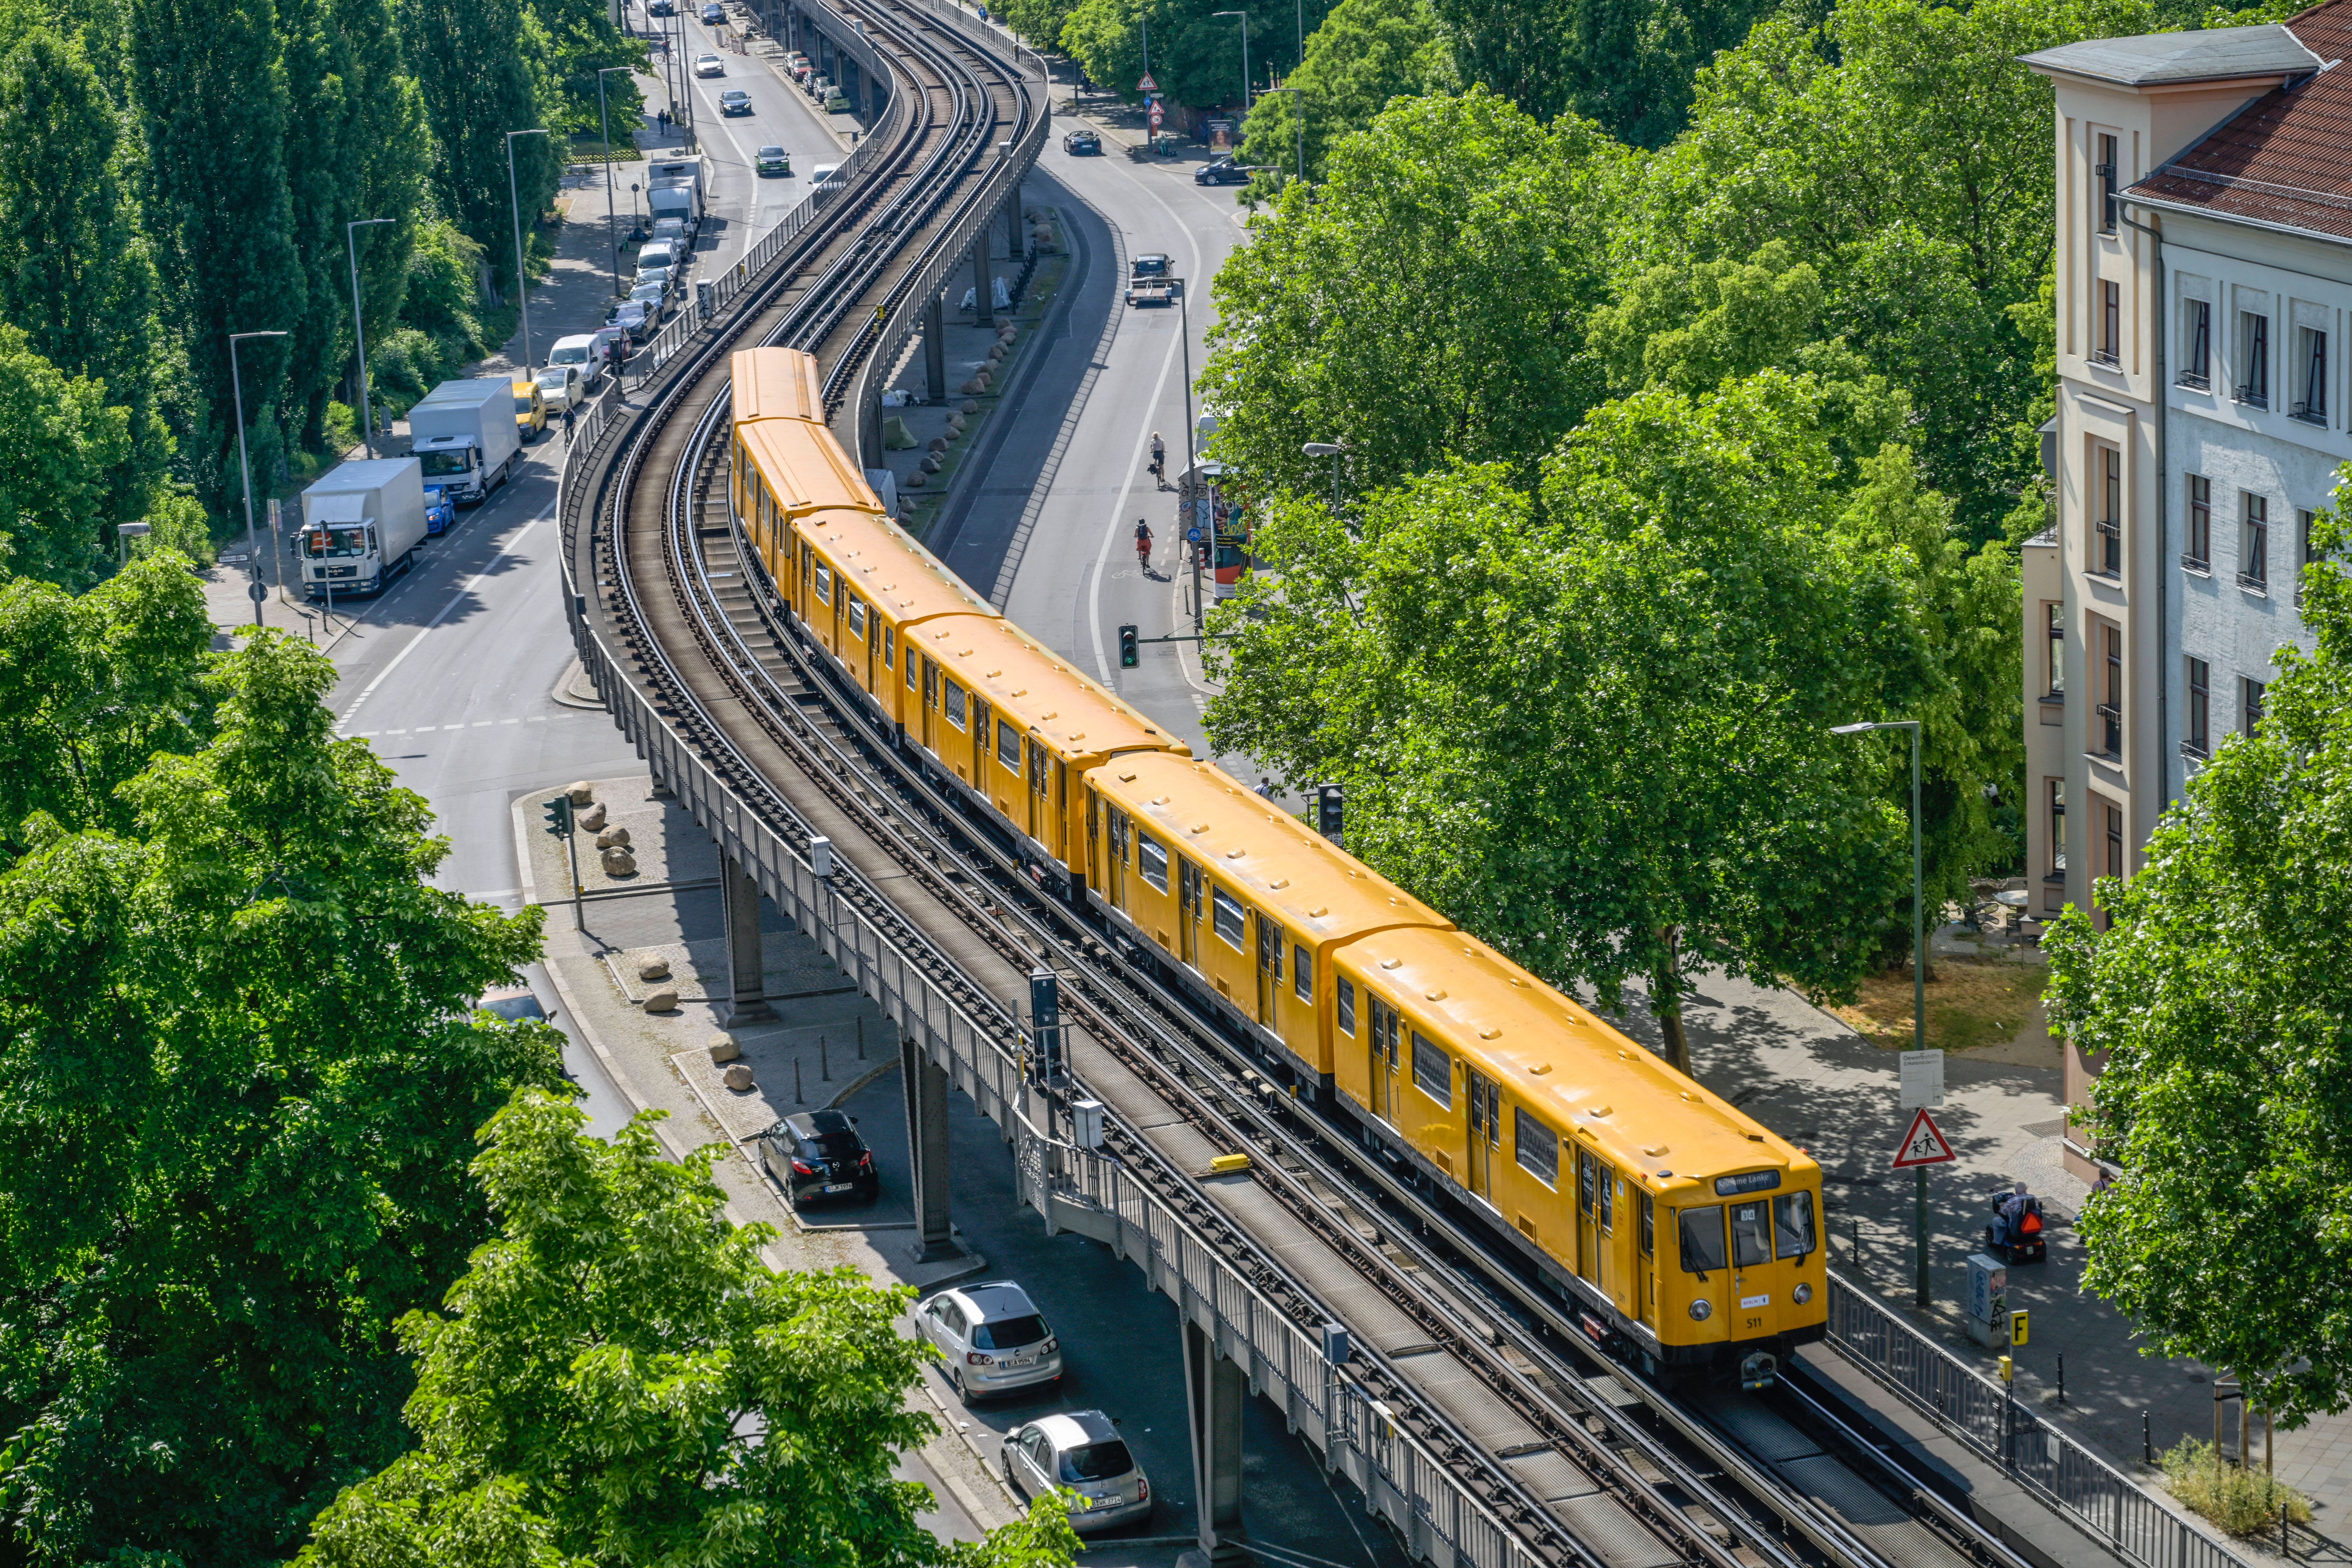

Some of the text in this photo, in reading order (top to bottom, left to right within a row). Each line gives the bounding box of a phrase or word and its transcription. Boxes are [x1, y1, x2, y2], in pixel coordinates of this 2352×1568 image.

[877, 307, 882, 317] F
[1748, 1173, 1769, 1183] Lanke
[1747, 1318, 1761, 1329] 511
[2015, 1316, 2026, 1341] F
